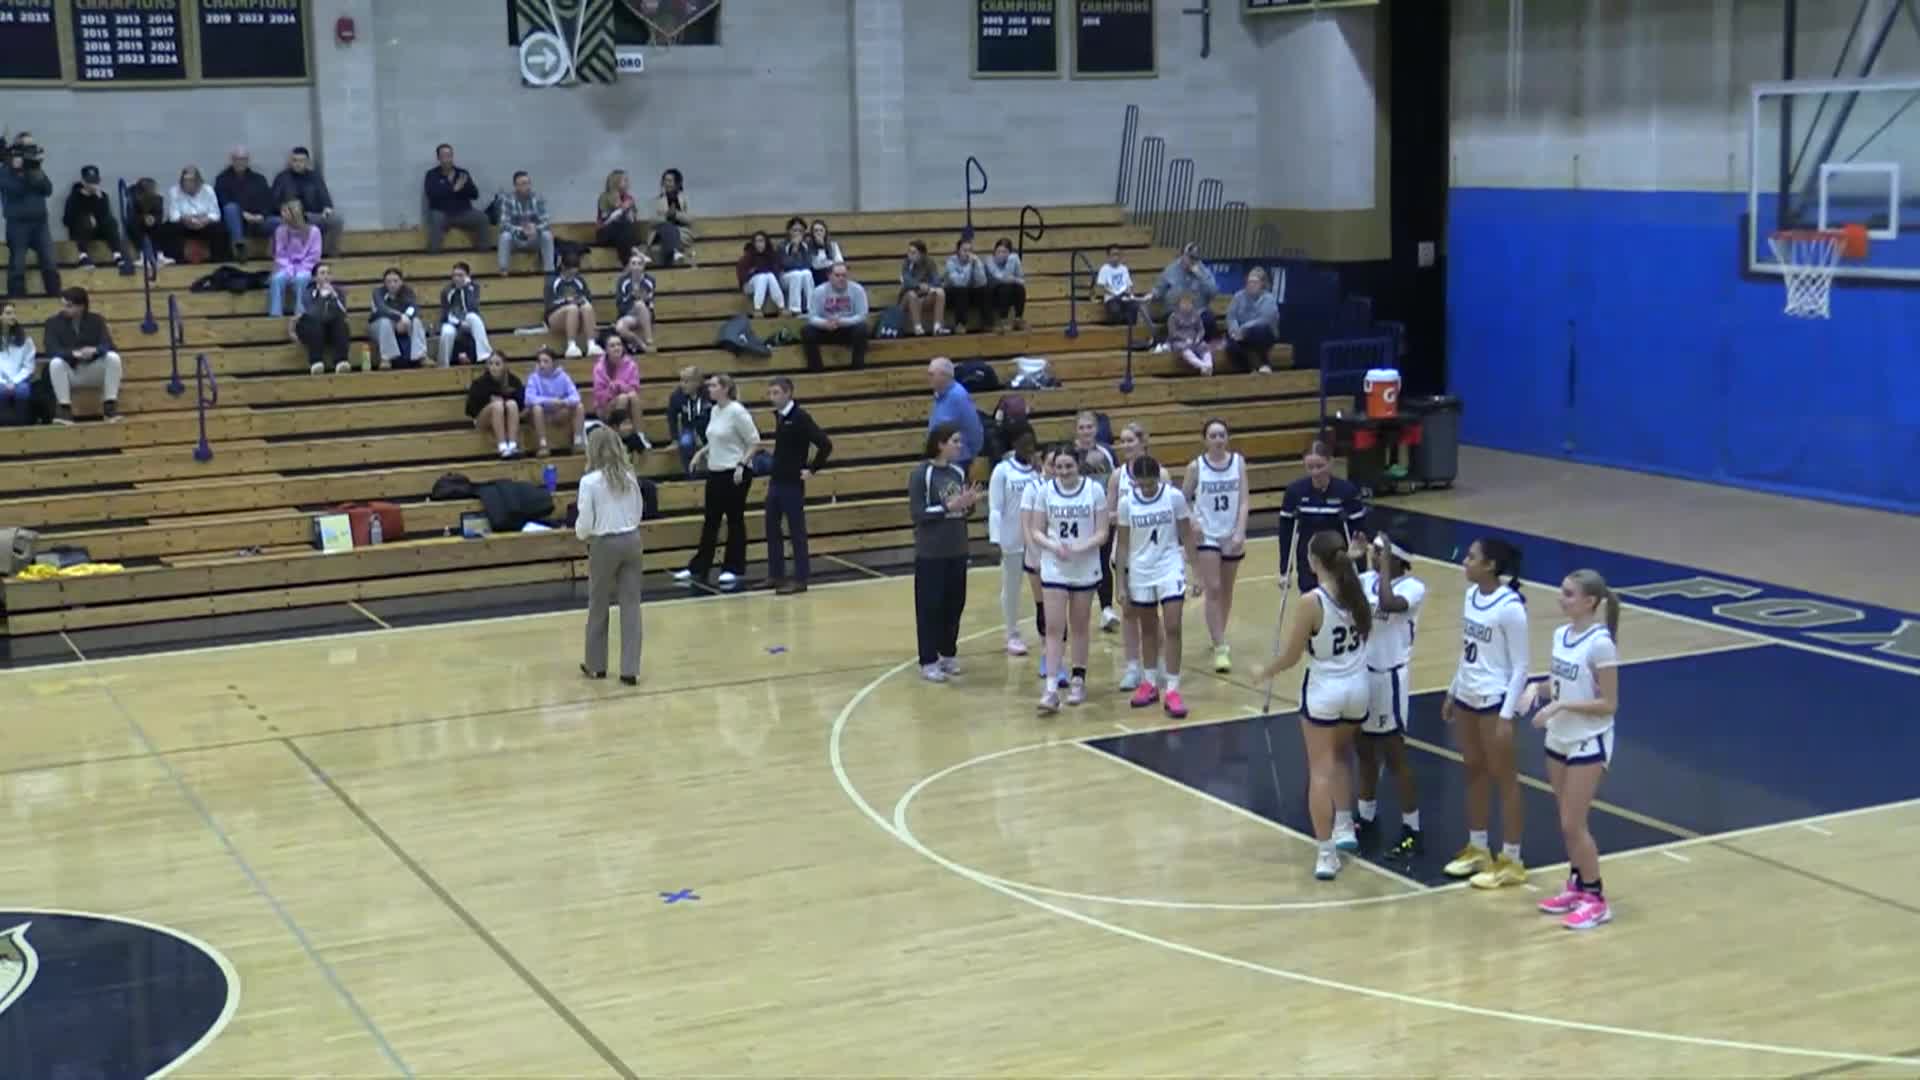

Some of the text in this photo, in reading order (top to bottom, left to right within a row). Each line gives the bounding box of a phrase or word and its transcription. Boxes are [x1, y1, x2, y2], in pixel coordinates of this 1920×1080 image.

[147, 14, 174, 24] 2014
[205, 14, 232, 24] 2019
[270, 14, 297, 24] 2024
[82, 27, 109, 38] 2015
[149, 26, 174, 37] 2017
[151, 41, 176, 51] 2021
[150, 53, 178, 64] 2024
[1383, 387, 1395, 402] G
[1214, 495, 1229, 512] 13
[1060, 521, 1079, 538] 24
[1150, 528, 1158, 544] 4
[1332, 626, 1360, 656] 23
